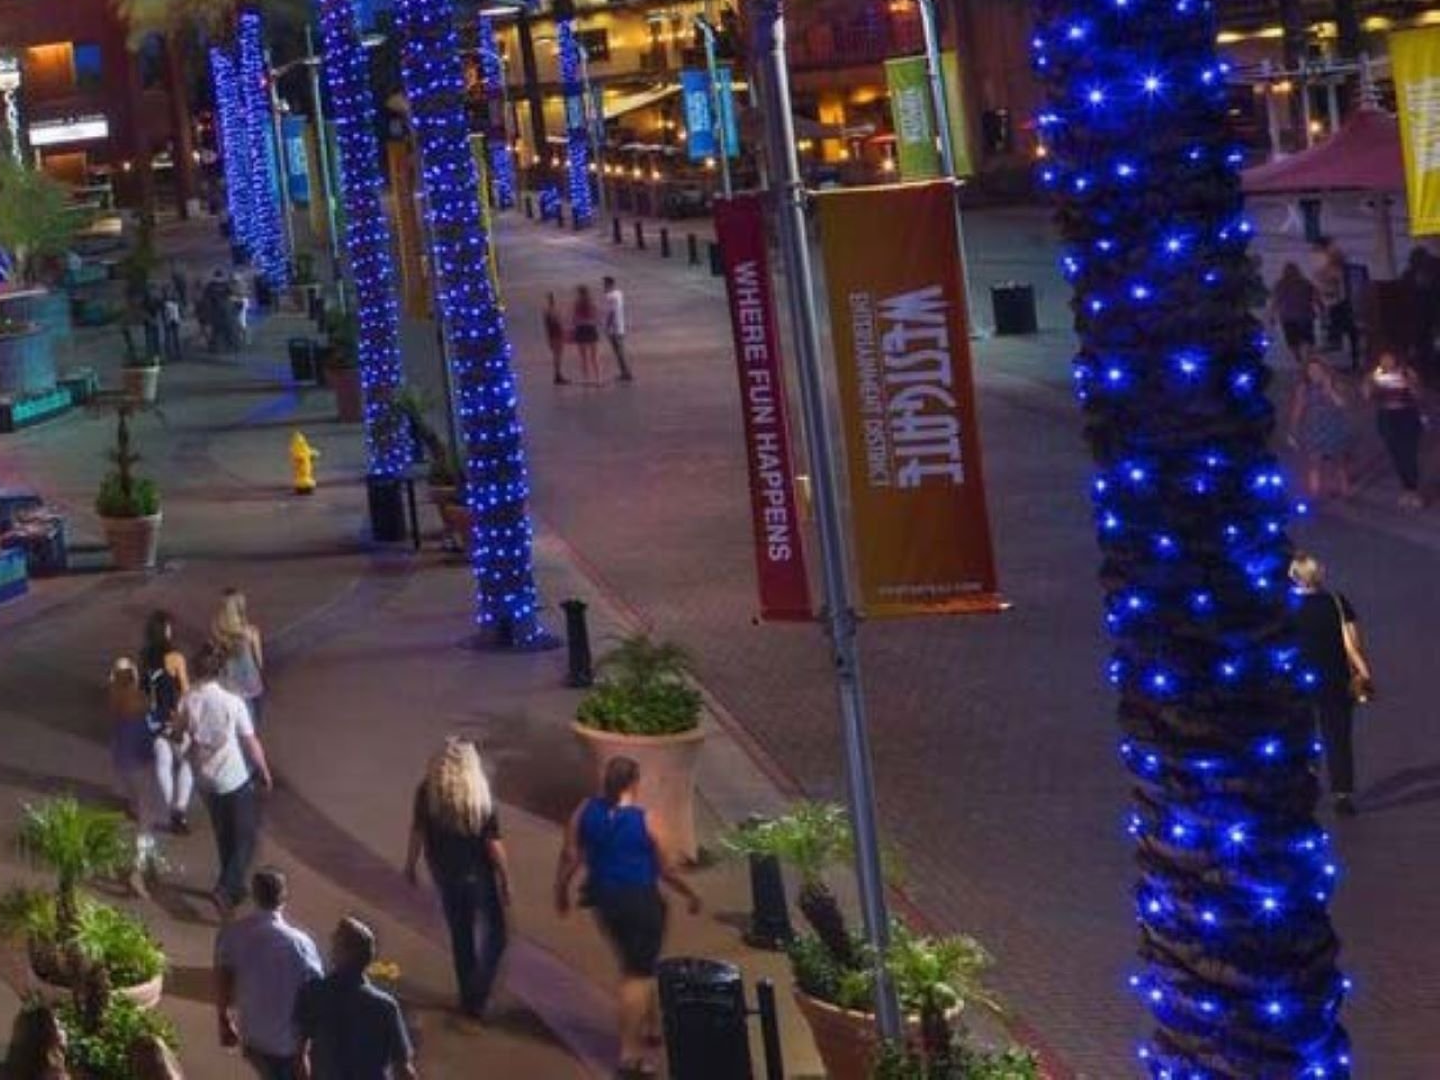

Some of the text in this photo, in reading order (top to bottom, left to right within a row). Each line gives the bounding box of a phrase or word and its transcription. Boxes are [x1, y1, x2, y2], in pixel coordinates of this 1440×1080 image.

[733, 261, 791, 562] WHERE FUN HAPPENS
[848, 291, 891, 487] ENTERTAINMENT DISTRICT
[877, 285, 965, 489] WESTGATE
